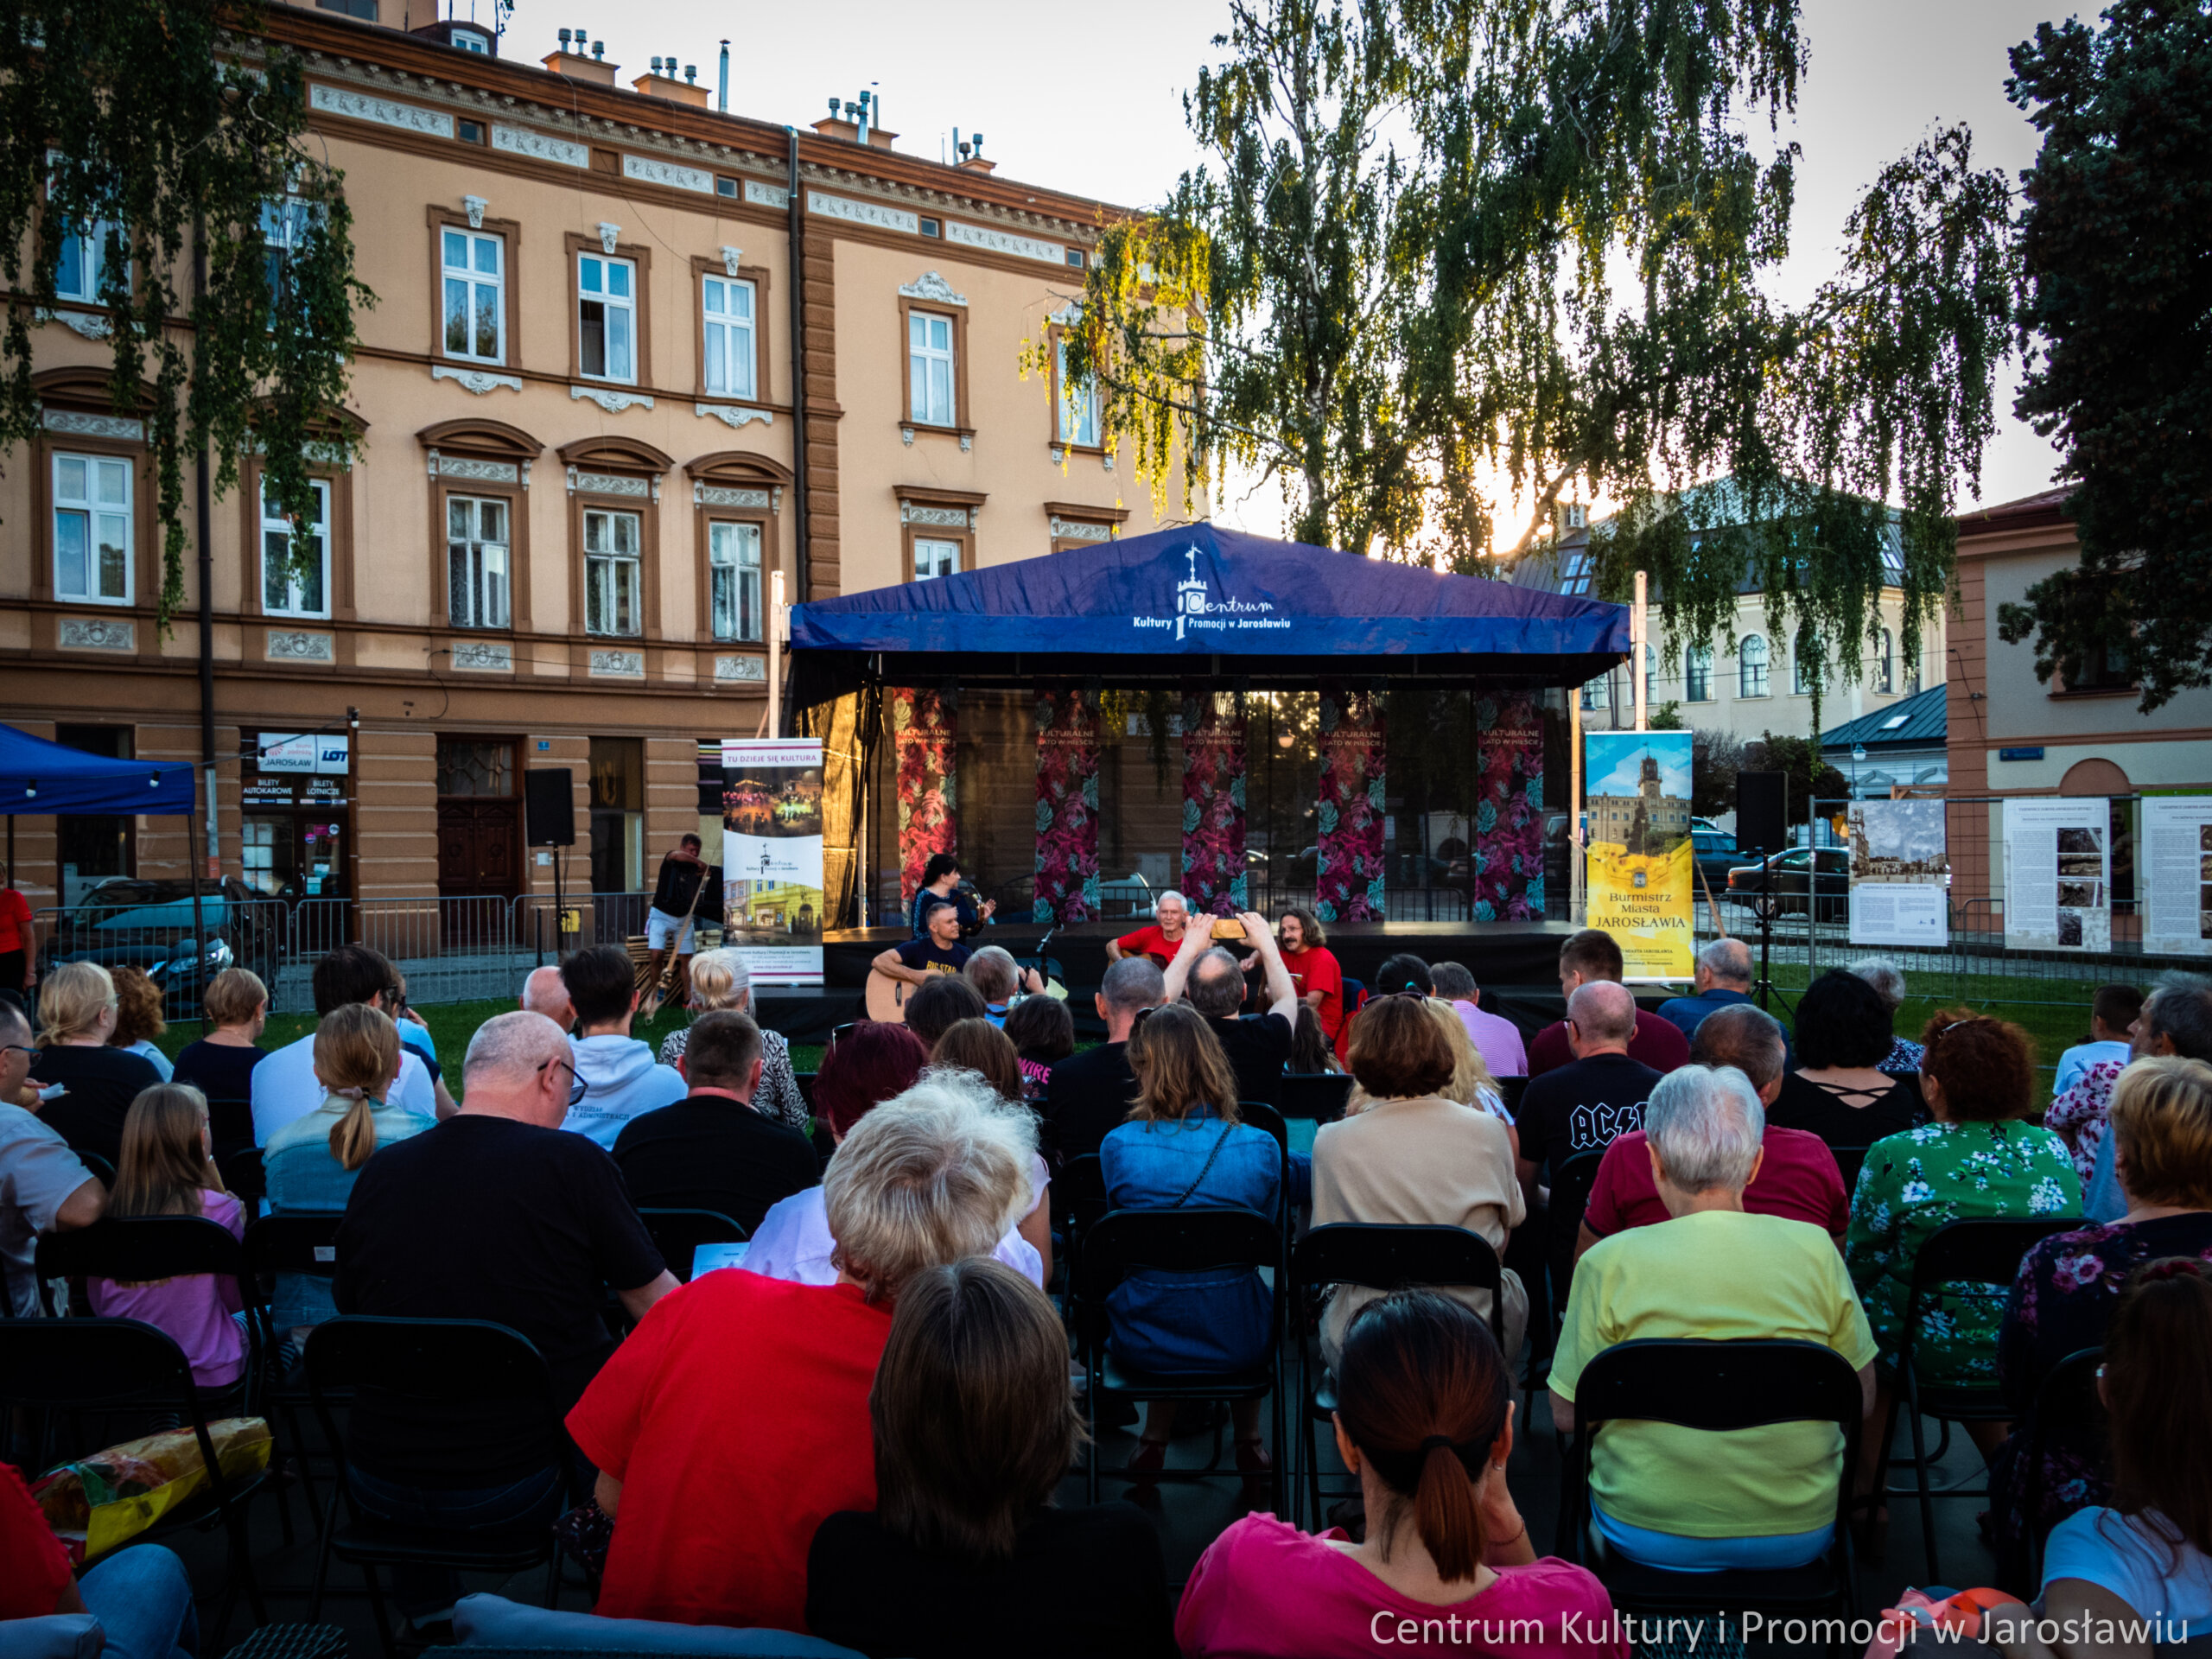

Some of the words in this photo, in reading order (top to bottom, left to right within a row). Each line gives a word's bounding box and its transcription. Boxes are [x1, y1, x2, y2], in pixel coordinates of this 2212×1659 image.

[1187, 592, 1274, 613] Centrum
[1133, 616, 1173, 630] Kultury
[1188, 617, 1226, 631] Promocji
[1237, 617, 1291, 628] Jarosławiu
[321, 750, 348, 762] LOT
[767, 755, 779, 764] SIĘ
[1610, 893, 1672, 902] Burmistrz
[1621, 905, 1660, 913] Miasta
[1596, 917, 1686, 928] JAROSŁAWIA
